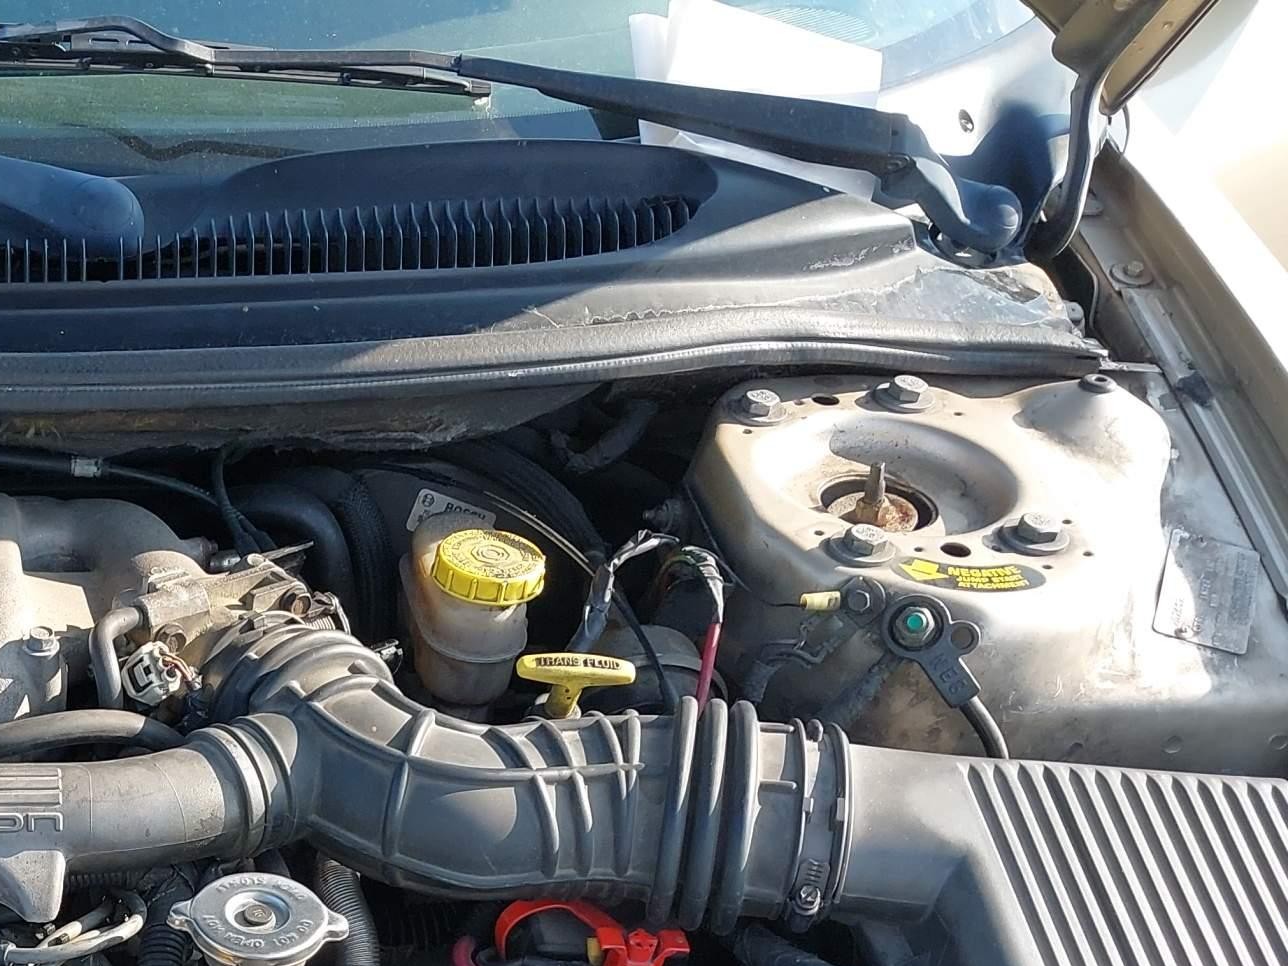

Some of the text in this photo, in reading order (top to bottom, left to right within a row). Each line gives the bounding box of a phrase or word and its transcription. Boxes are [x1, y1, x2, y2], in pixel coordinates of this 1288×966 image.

[947, 565, 1022, 577] NEGATIVE
[957, 579, 1031, 589] ATTACHMENT
[992, 574, 1025, 583] START
[535, 655, 621, 670] TRANS FLUID
